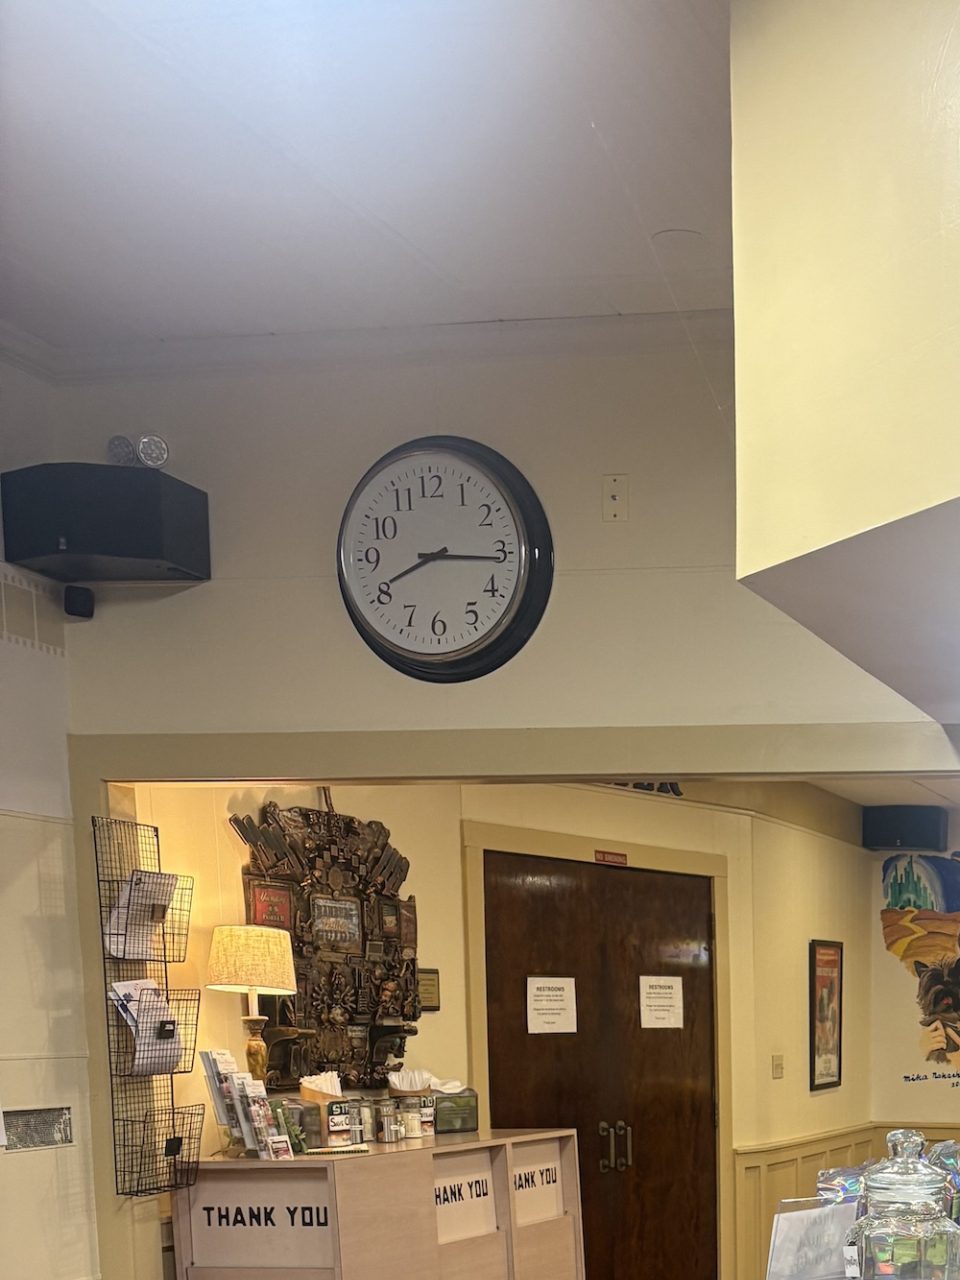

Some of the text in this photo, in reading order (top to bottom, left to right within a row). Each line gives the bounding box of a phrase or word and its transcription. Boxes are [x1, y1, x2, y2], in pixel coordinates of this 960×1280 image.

[418, 475, 444, 498] 12
[457, 483, 467, 506] 1
[392, 487, 415, 511] 11
[372, 515, 398, 540] 10
[478, 504, 493, 527] 2
[364, 547, 380, 573] 9
[492, 540, 507, 563] 3
[377, 581, 393, 605] 8
[482, 573, 499, 598] 4
[403, 604, 417, 627] 7
[431, 611, 447, 637] 6
[465, 601, 479, 625] 5
[539, 1167, 557, 1185] YOU
[434, 1179, 488, 1205] HANK YOU
[203, 1206, 328, 1227] THANK YOU
